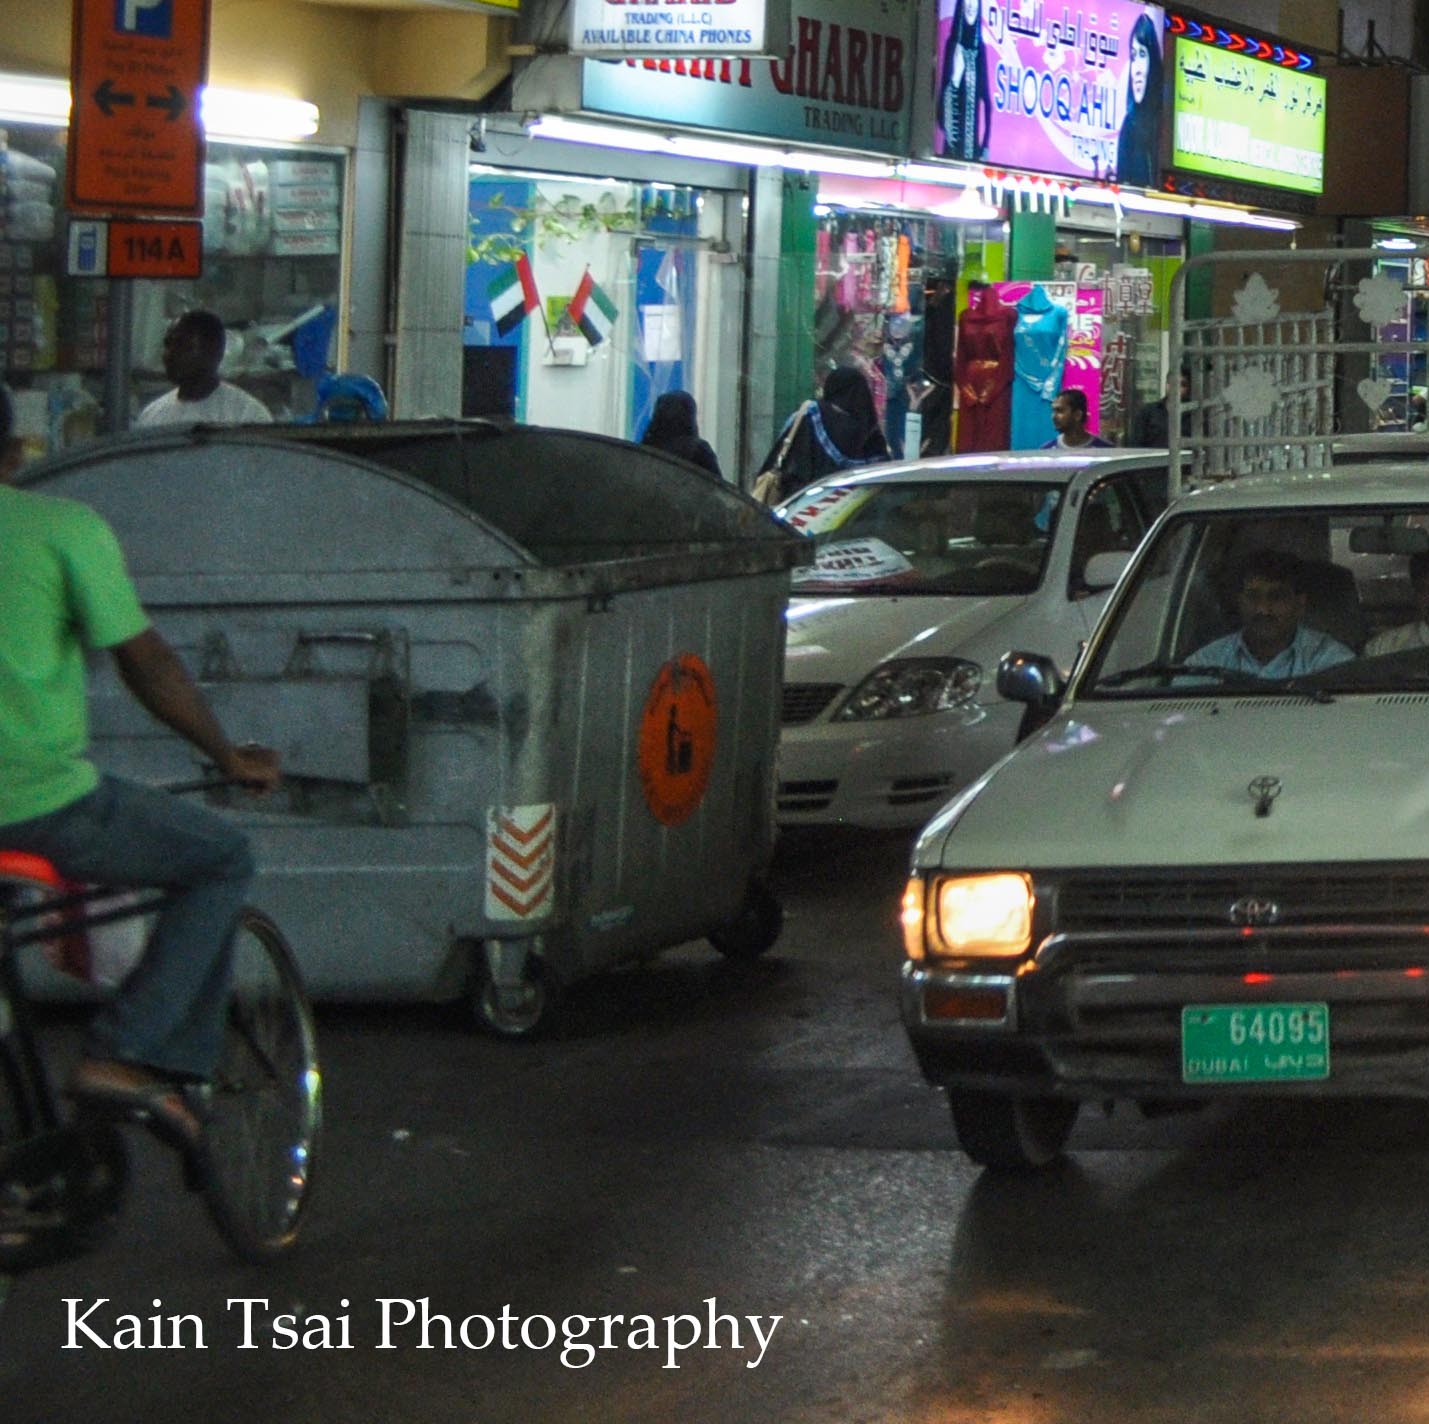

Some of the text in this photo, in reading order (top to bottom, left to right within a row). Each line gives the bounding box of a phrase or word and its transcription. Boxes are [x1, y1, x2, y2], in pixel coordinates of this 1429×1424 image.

[624, 11, 674, 26] TRADING
[582, 28, 752, 45] AVAILABLE CHINA PHONES
[993, 62, 1118, 131] SHOOQ AHLI
[803, 105, 864, 135] TRADING
[1229, 1009, 1325, 1046] 64095
[1187, 1057, 1250, 1075] DUBAI
